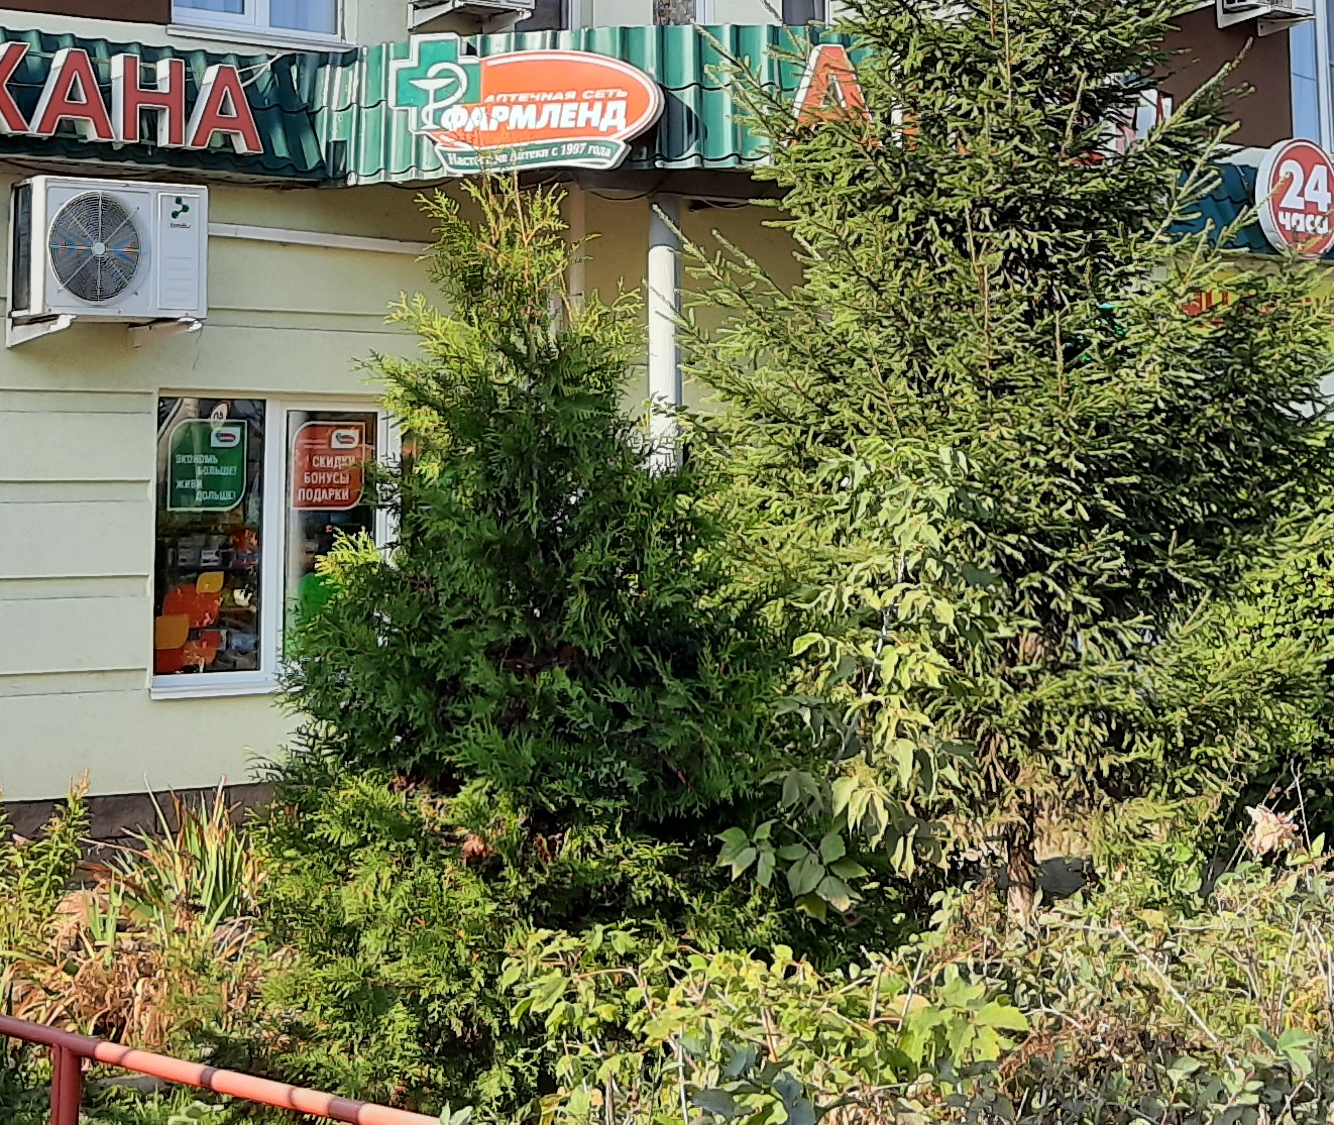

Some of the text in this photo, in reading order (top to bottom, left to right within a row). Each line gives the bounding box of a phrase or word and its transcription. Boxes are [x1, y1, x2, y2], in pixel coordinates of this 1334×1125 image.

[484, 88, 629, 104] АПТЕЧНАЯ СЕТЬ
[440, 100, 628, 132] ФАРМЛЕНД
[560, 142, 587, 156] 1997
[588, 144, 612, 158] года
[1279, 159, 1331, 212] 24
[1278, 210, 1328, 235] часа
[312, 454, 356, 469] СКИДКИ
[304, 472, 350, 485] БОНУСЫ
[298, 488, 350, 502] ПОДАРКИ
